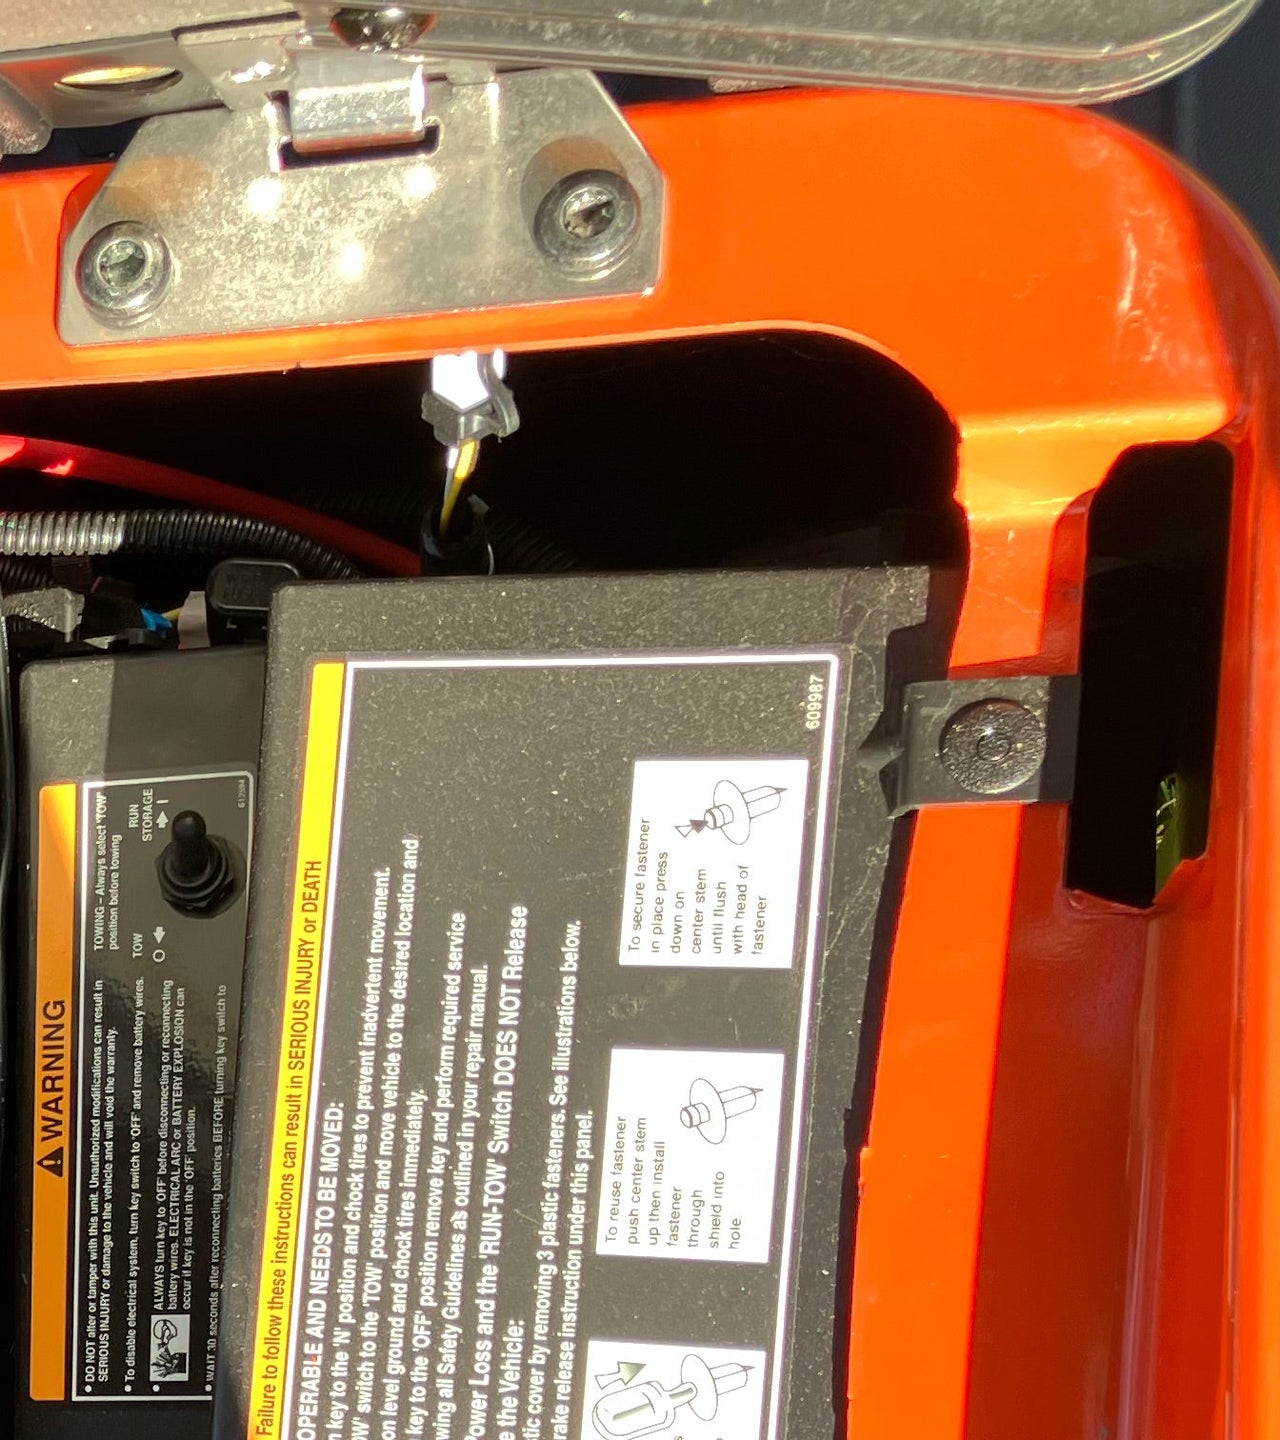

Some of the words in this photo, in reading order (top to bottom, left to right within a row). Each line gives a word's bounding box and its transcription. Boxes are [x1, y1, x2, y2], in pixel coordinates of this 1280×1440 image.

[805, 674, 823, 730] 609987
[128, 803, 139, 827] RUN
[141, 788, 153, 841] STORAGE
[95, 825, 106, 855] select
[109, 834, 122, 869] towing
[95, 857, 108, 895] Always
[108, 871, 119, 905] before
[301, 861, 321, 912] DEATH
[93, 906, 104, 951] TOWING
[107, 907, 119, 950] position
[303, 917, 316, 933] or
[370, 866, 390, 953] movement.
[132, 933, 142, 958] TOW
[501, 905, 528, 979] Release
[93, 980, 102, 990] in
[294, 937, 314, 994] INJURY
[93, 992, 102, 1022] result
[358, 956, 383, 1046] inadvertent
[497, 983, 521, 1025] NOT
[93, 1024, 102, 1044] can
[287, 999, 310, 1070] SERIOUS
[40, 1000, 65, 1141] WARNING
[492, 1030, 518, 1085] DOES
[90, 1046, 102, 1116] modifications
[286, 1075, 303, 1088] in
[356, 1049, 375, 1110] prevent
[284, 1093, 301, 1136] result
[351, 1113, 369, 1130] to
[487, 1090, 512, 1153] Switch
[574, 1110, 594, 1159] panel.
[89, 1119, 100, 1188] Unauthorized
[282, 1141, 297, 1168] can
[319, 1102, 344, 1172] MOVED:
[347, 1133, 368, 1169] tires
[316, 1176, 337, 1201] BE
[343, 1172, 364, 1221] chock
[569, 1162, 589, 1194] this
[88, 1191, 98, 1214] unit.
[270, 1173, 294, 1263] instructions
[314, 1206, 335, 1230] TO
[478, 1158, 506, 1259] 'RUN-TOW'
[566, 1196, 586, 1245] under
[664, 1185, 682, 1247] fastener
[88, 1216, 98, 1236] this
[342, 1224, 360, 1255] and
[87, 1238, 97, 1260] with
[308, 1232, 333, 1294] NEEDS
[87, 1262, 99, 1299] tamper
[267, 1268, 286, 1310] these
[336, 1258, 357, 1323] position
[476, 1264, 498, 1295] the
[556, 1249, 582, 1337] instruction
[86, 1314, 96, 1338] alter
[88, 1301, 96, 1312] or
[305, 1298, 326, 1338] AND
[474, 1298, 495, 1335] and
[85, 1340, 95, 1363] NOT
[262, 1314, 282, 1360] follow
[332, 1327, 351, 1346] 'N'
[498, 1319, 524, 1393] Vehicle:
[85, 1365, 95, 1382] DO
[261, 1364, 278, 1379] to
[330, 1350, 349, 1377] the
[468, 1339, 492, 1385] Loss
[553, 1340, 575, 1400] release
[254, 1383, 276, 1435] Failure
[329, 1380, 347, 1398] to
[325, 1400, 349, 1429] key
[495, 1396, 518, 1427] the
